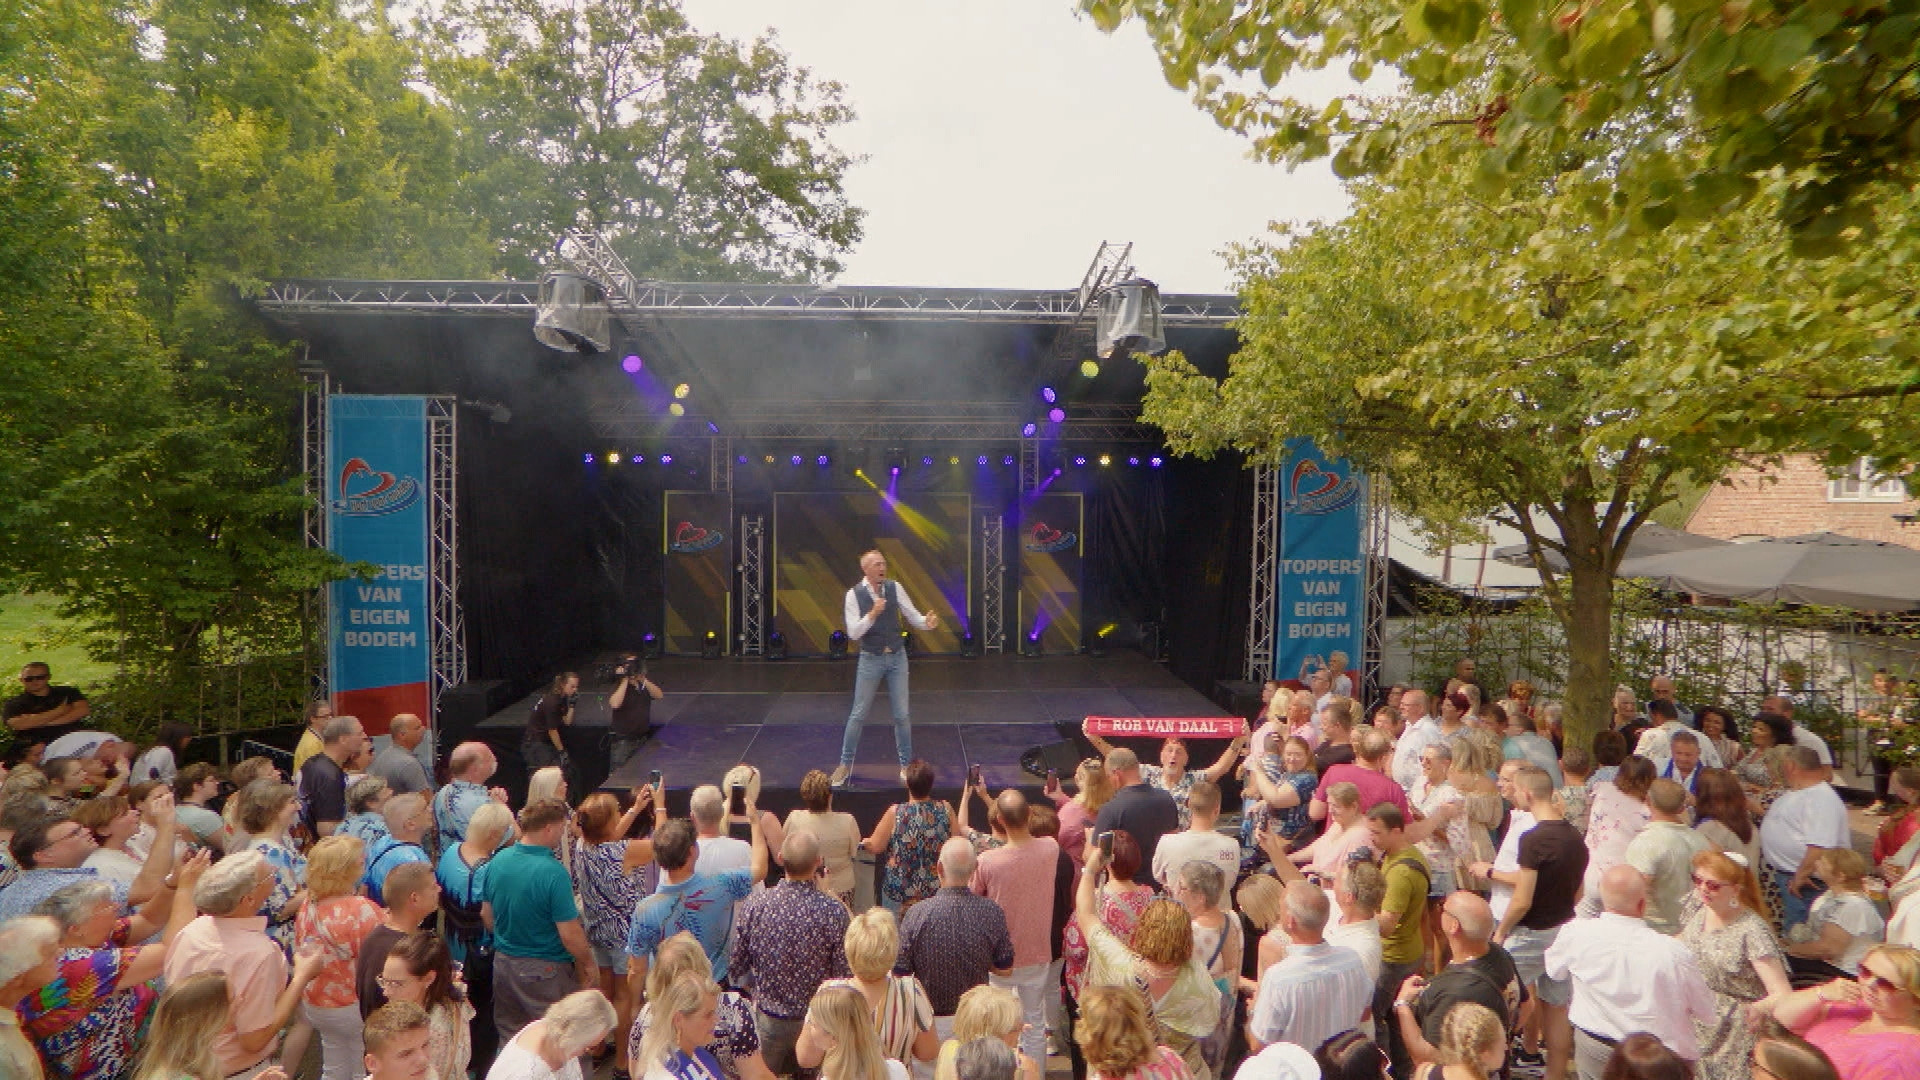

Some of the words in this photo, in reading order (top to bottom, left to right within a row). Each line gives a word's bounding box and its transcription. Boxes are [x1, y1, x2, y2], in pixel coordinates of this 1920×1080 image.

[349, 564, 425, 580] PERS
[1282, 559, 1362, 574] TOPPERS
[357, 587, 401, 602] VAN
[1303, 581, 1340, 595] VAN
[350, 609, 409, 625] EIGEN
[1294, 602, 1347, 617] EIGEN
[1289, 623, 1350, 638] BODEM
[345, 631, 416, 647] BODEM
[1112, 719, 1142, 732] ROB
[1146, 719, 1175, 733] VAN
[1179, 720, 1218, 733] DAAL
